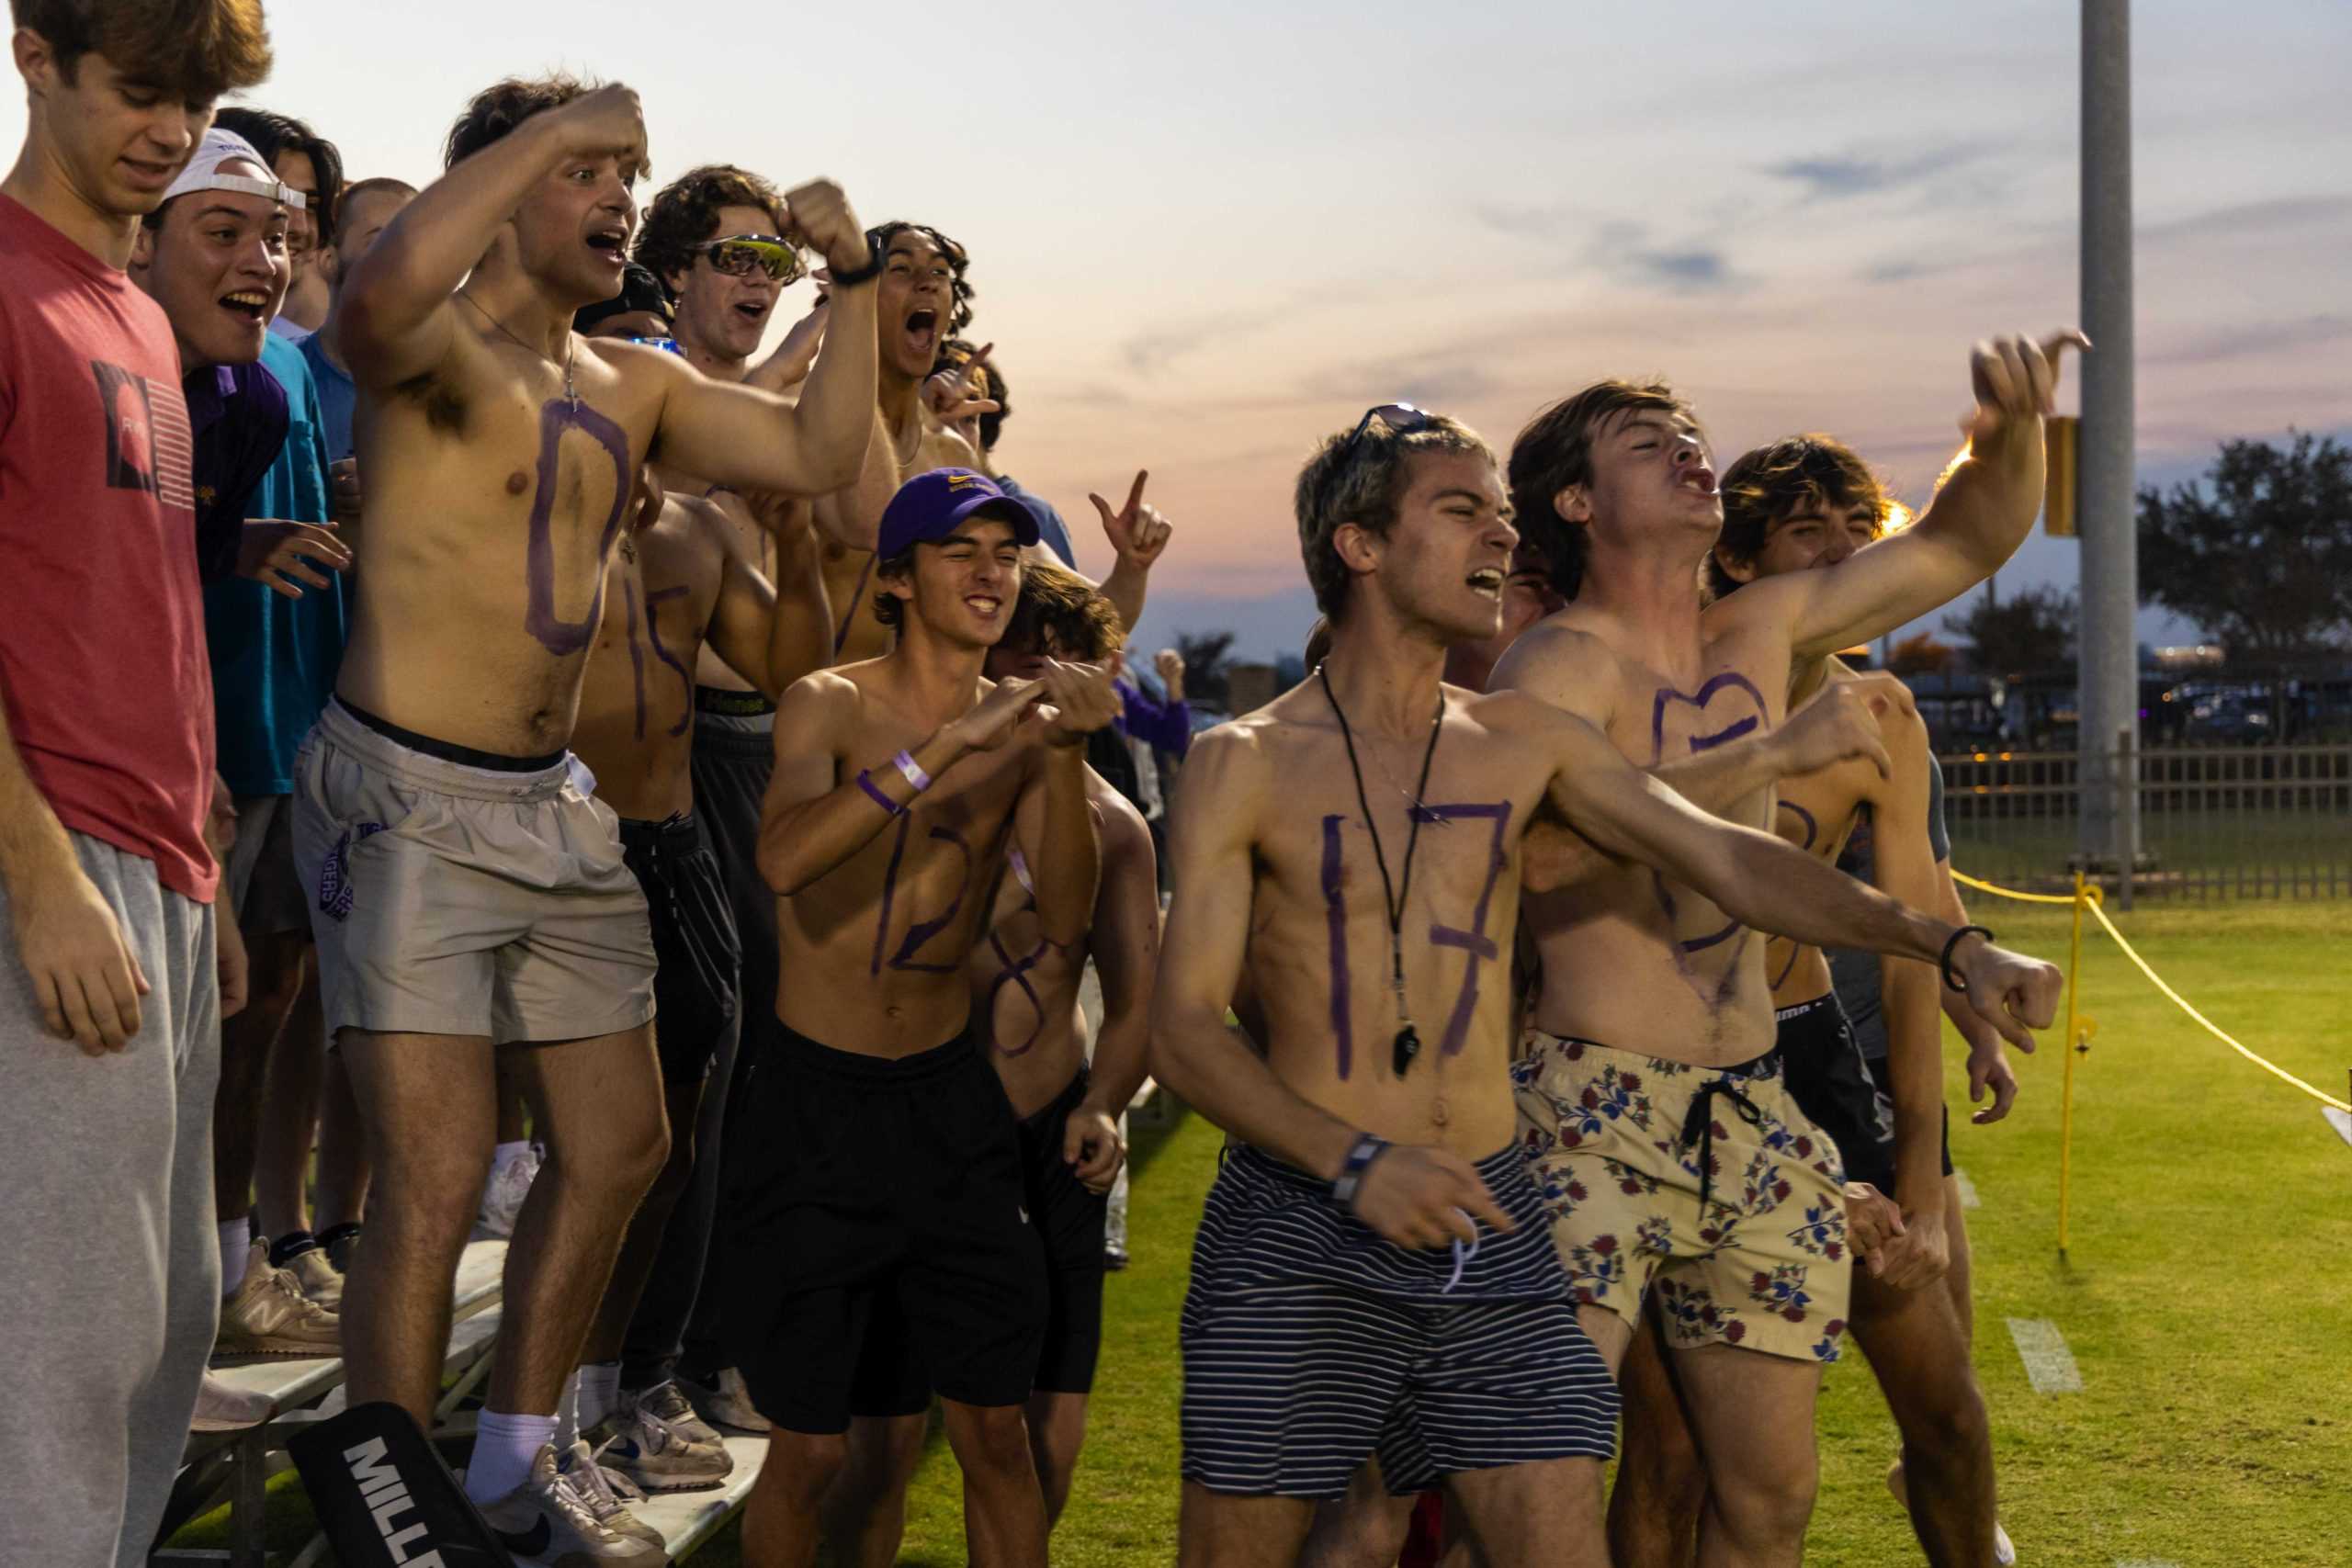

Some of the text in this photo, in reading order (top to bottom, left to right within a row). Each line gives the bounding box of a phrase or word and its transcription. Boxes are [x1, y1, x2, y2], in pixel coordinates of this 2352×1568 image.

[871, 808, 972, 978] 12
[1321, 798, 1512, 1081] 17
[343, 1435, 446, 1568] MILL
